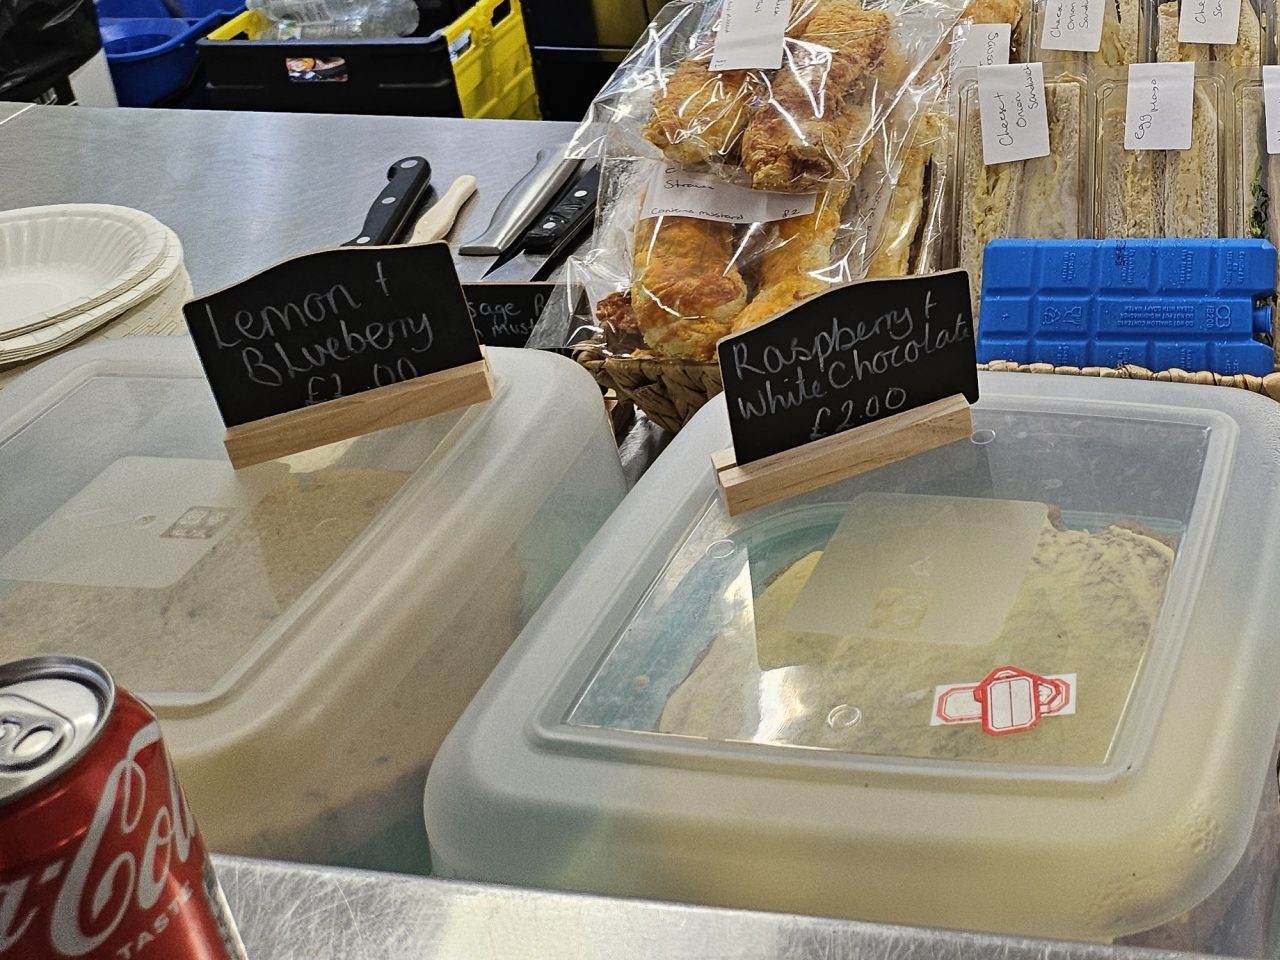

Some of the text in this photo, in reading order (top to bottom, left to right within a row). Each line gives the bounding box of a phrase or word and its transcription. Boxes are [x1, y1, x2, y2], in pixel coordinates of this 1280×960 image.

[1050, 2, 1063, 38] Cheese
[998, 101, 1014, 147] Cheese
[1014, 91, 1027, 128] Onion
[205, 260, 391, 351] Lemon +
[733, 290, 938, 380] Raspberry +
[738, 366, 828, 420] White
[808, 386, 907, 440] £2.00
[115, 879, 194, 960] TASTE
